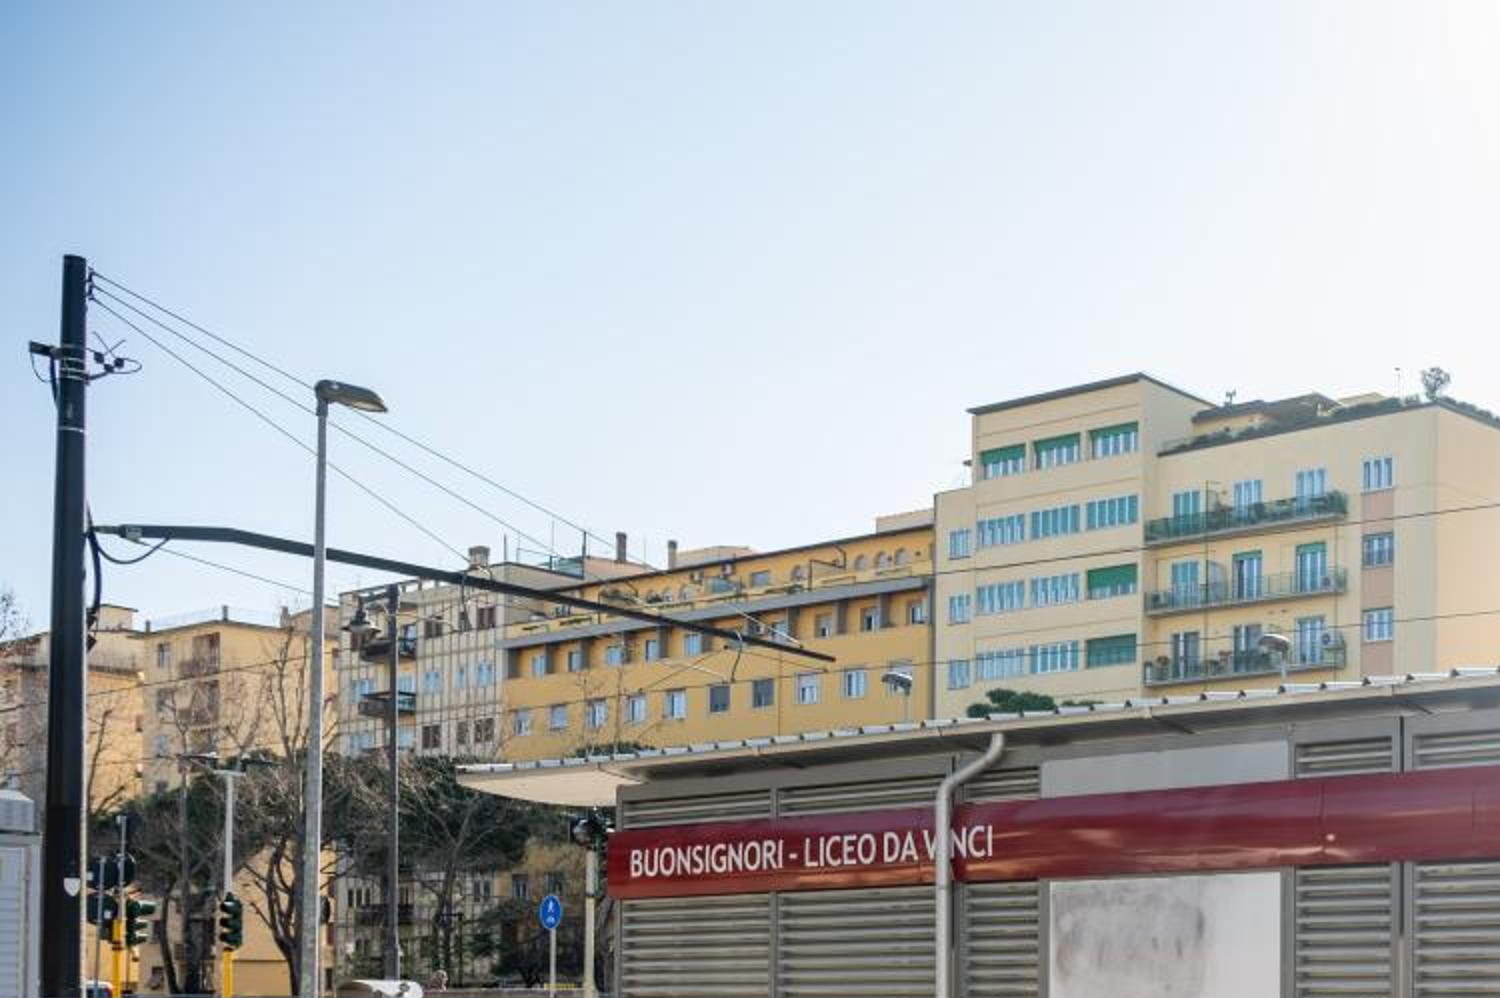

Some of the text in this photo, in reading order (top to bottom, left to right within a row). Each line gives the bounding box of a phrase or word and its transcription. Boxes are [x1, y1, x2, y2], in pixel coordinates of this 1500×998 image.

[630, 839, 783, 878] BUONSIGNORI
[804, 833, 877, 868] LICEO
[883, 830, 919, 863] DA
[922, 824, 993, 860] VNCI
